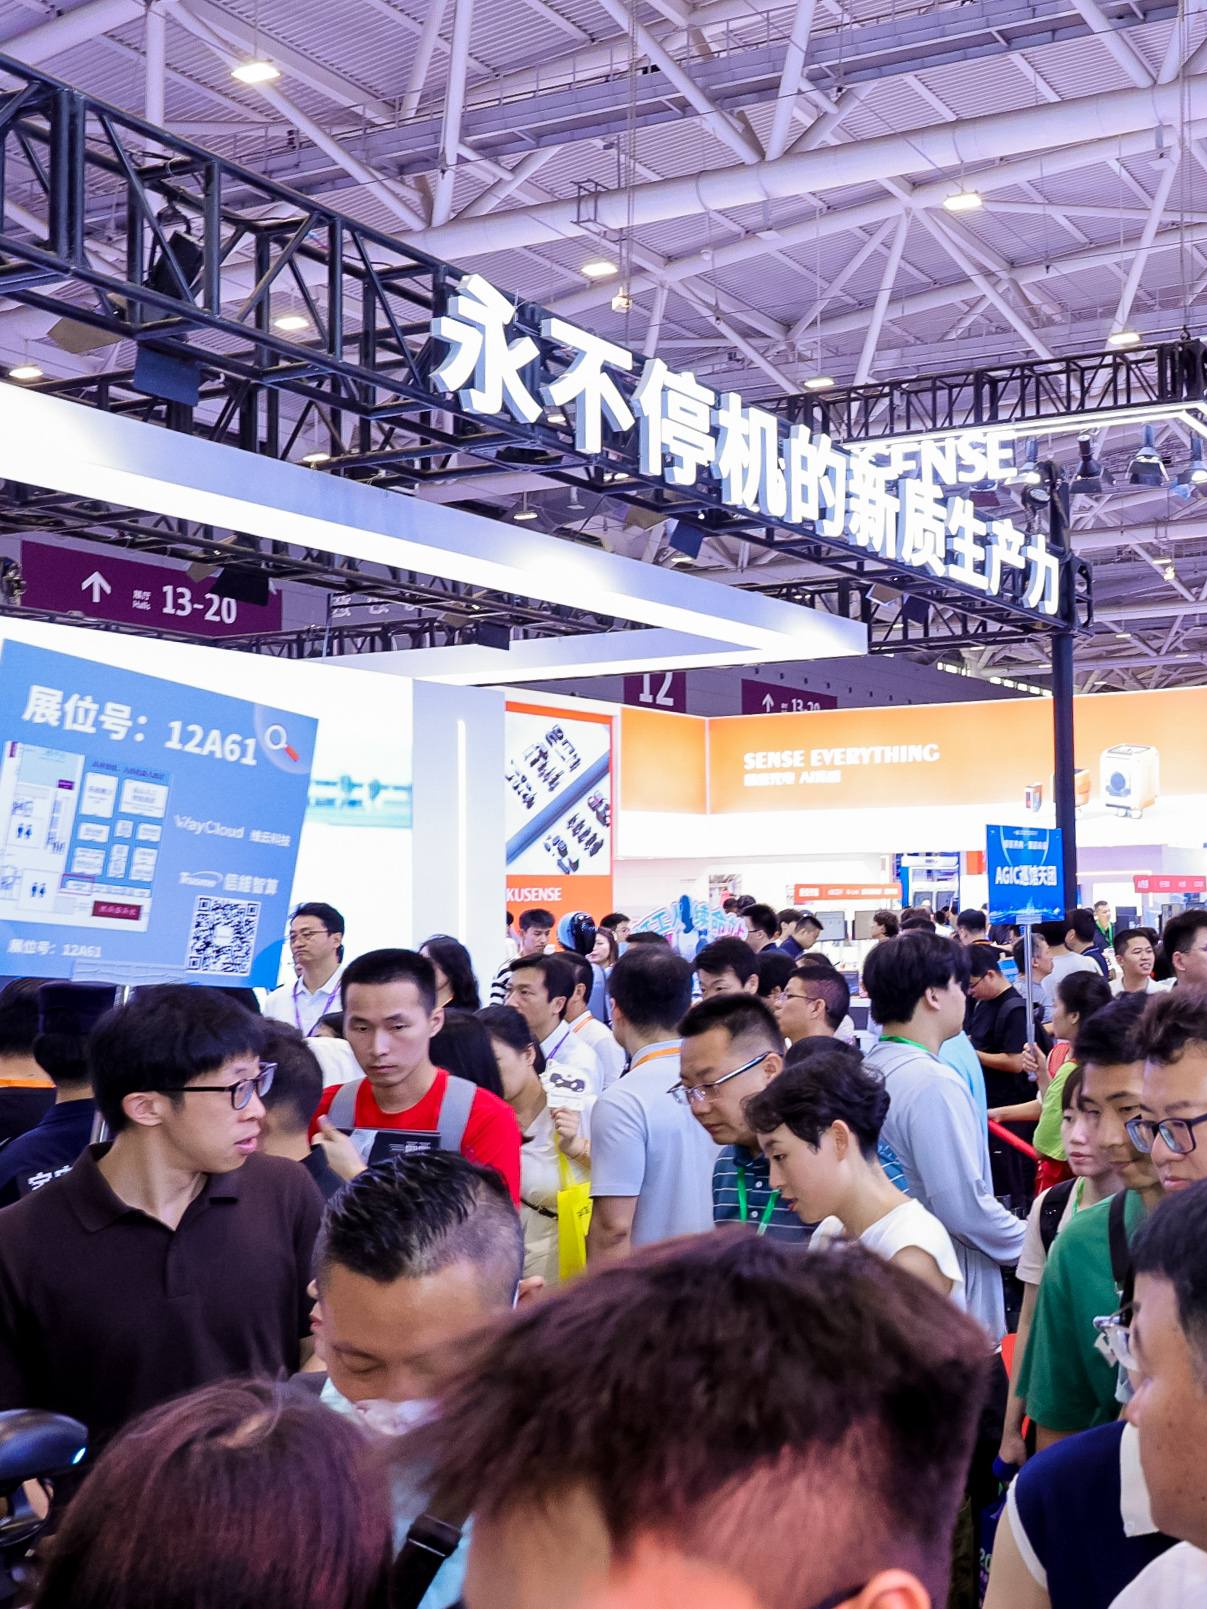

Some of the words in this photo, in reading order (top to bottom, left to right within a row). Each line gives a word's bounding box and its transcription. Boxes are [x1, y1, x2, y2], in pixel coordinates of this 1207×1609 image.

[430, 273, 1061, 615] 永不停机的新质生产力
[162, 585, 238, 624] 13-20
[638, 672, 674, 706] 12
[164, 720, 257, 766] 12A61
[743, 750, 805, 770] SENSE
[810, 743, 941, 767] EVERYTHING
